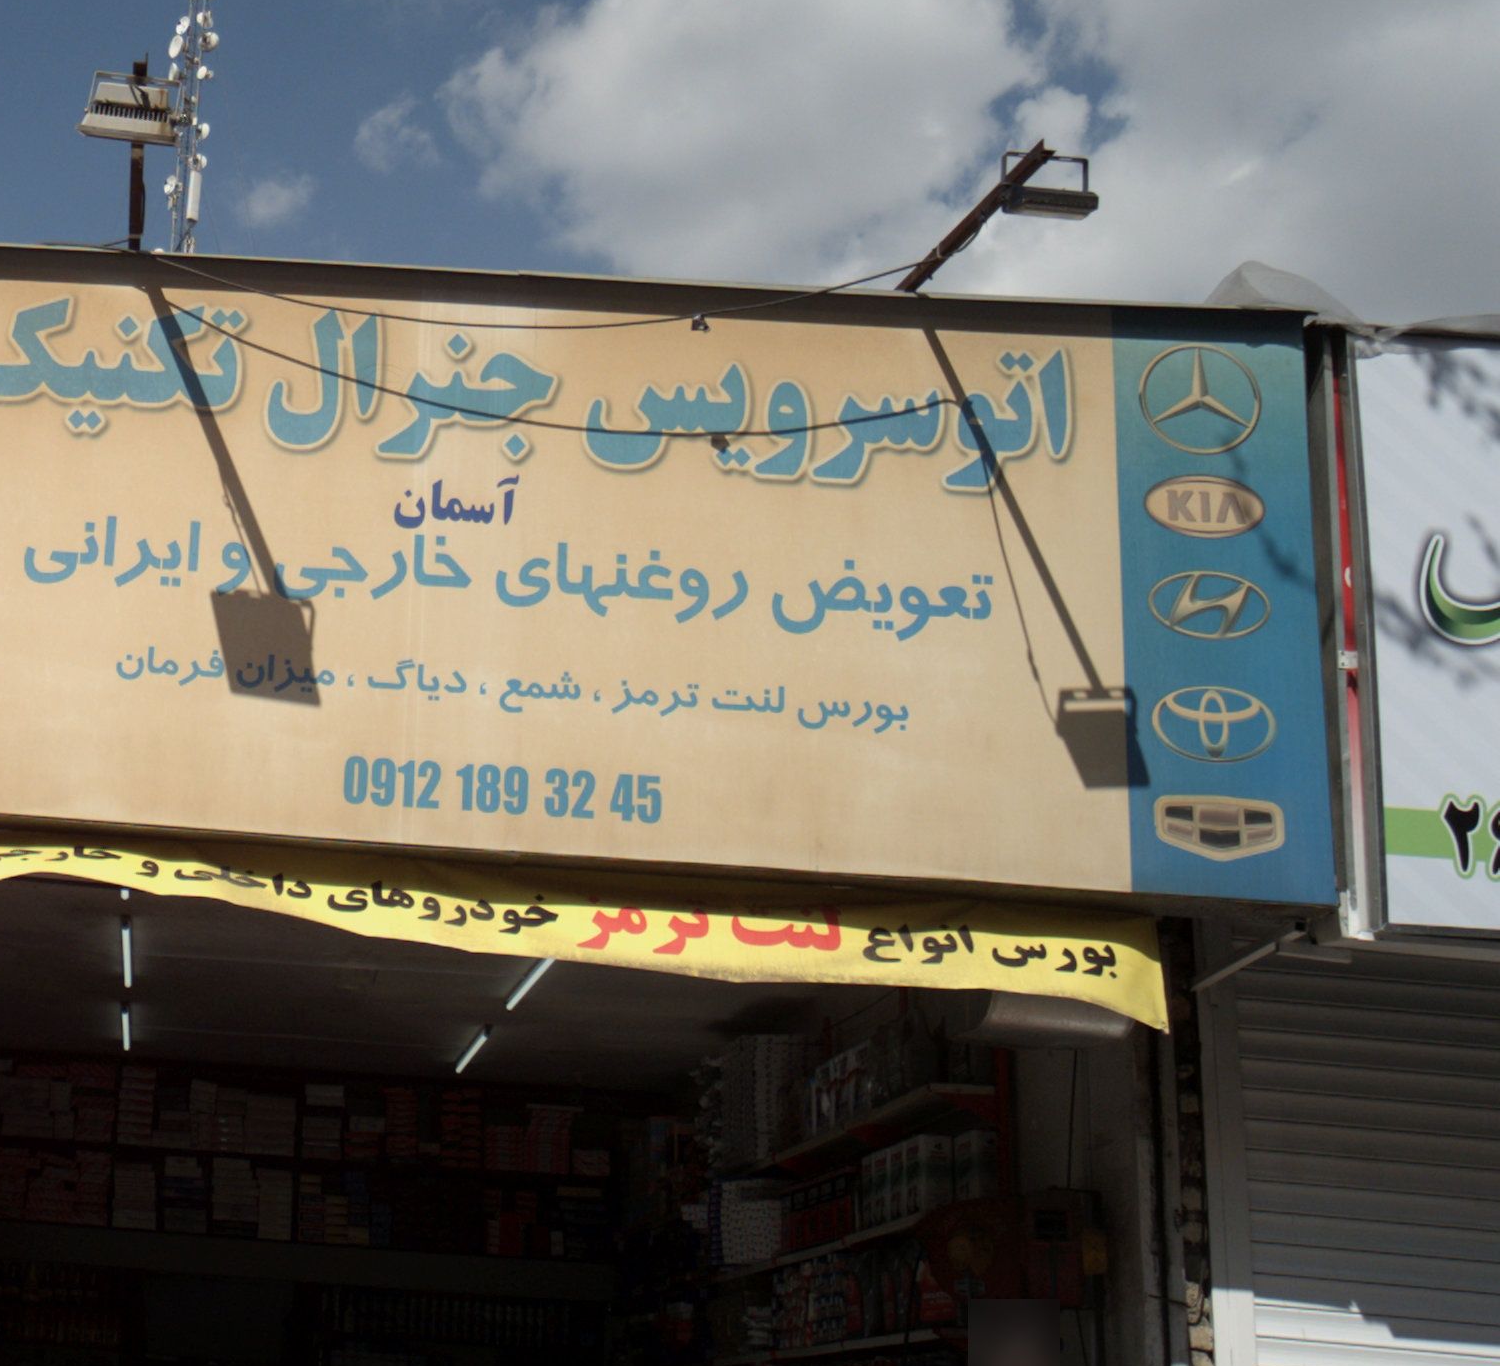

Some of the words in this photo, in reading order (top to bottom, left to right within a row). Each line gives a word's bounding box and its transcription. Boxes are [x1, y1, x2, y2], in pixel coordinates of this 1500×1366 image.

[264, 306, 560, 460] جنرال
[393, 474, 520, 529] آسمان
[1166, 489, 1247, 525] KIA
[23, 515, 202, 587] ایرانی
[216, 540, 251, 595] و
[273, 534, 472, 601] خارجی
[495, 542, 749, 624] روغنهای
[772, 558, 994, 642] تعویض
[115, 647, 225, 686] فرمان
[235, 654, 336, 692] میزان
[367, 659, 468, 702] دیاگ
[498, 671, 581, 713] شمع
[611, 679, 700, 717] ترمز
[710, 686, 785, 714] لنت
[797, 698, 910, 734] بورس
[343, 755, 442, 809] 0912
[456, 763, 529, 816] 189
[544, 768, 596, 819] 32
[609, 773, 662, 824] 45
[1443, 799, 1500, 876] ۲
[136, 858, 160, 878] و
[174, 864, 312, 899] داخلی
[327, 880, 560, 934] خودروهای
[576, 895, 710, 954] ترمز
[731, 905, 842, 951] لنت
[861, 922, 976, 963] انواع
[991, 936, 1118, 979] بورس
